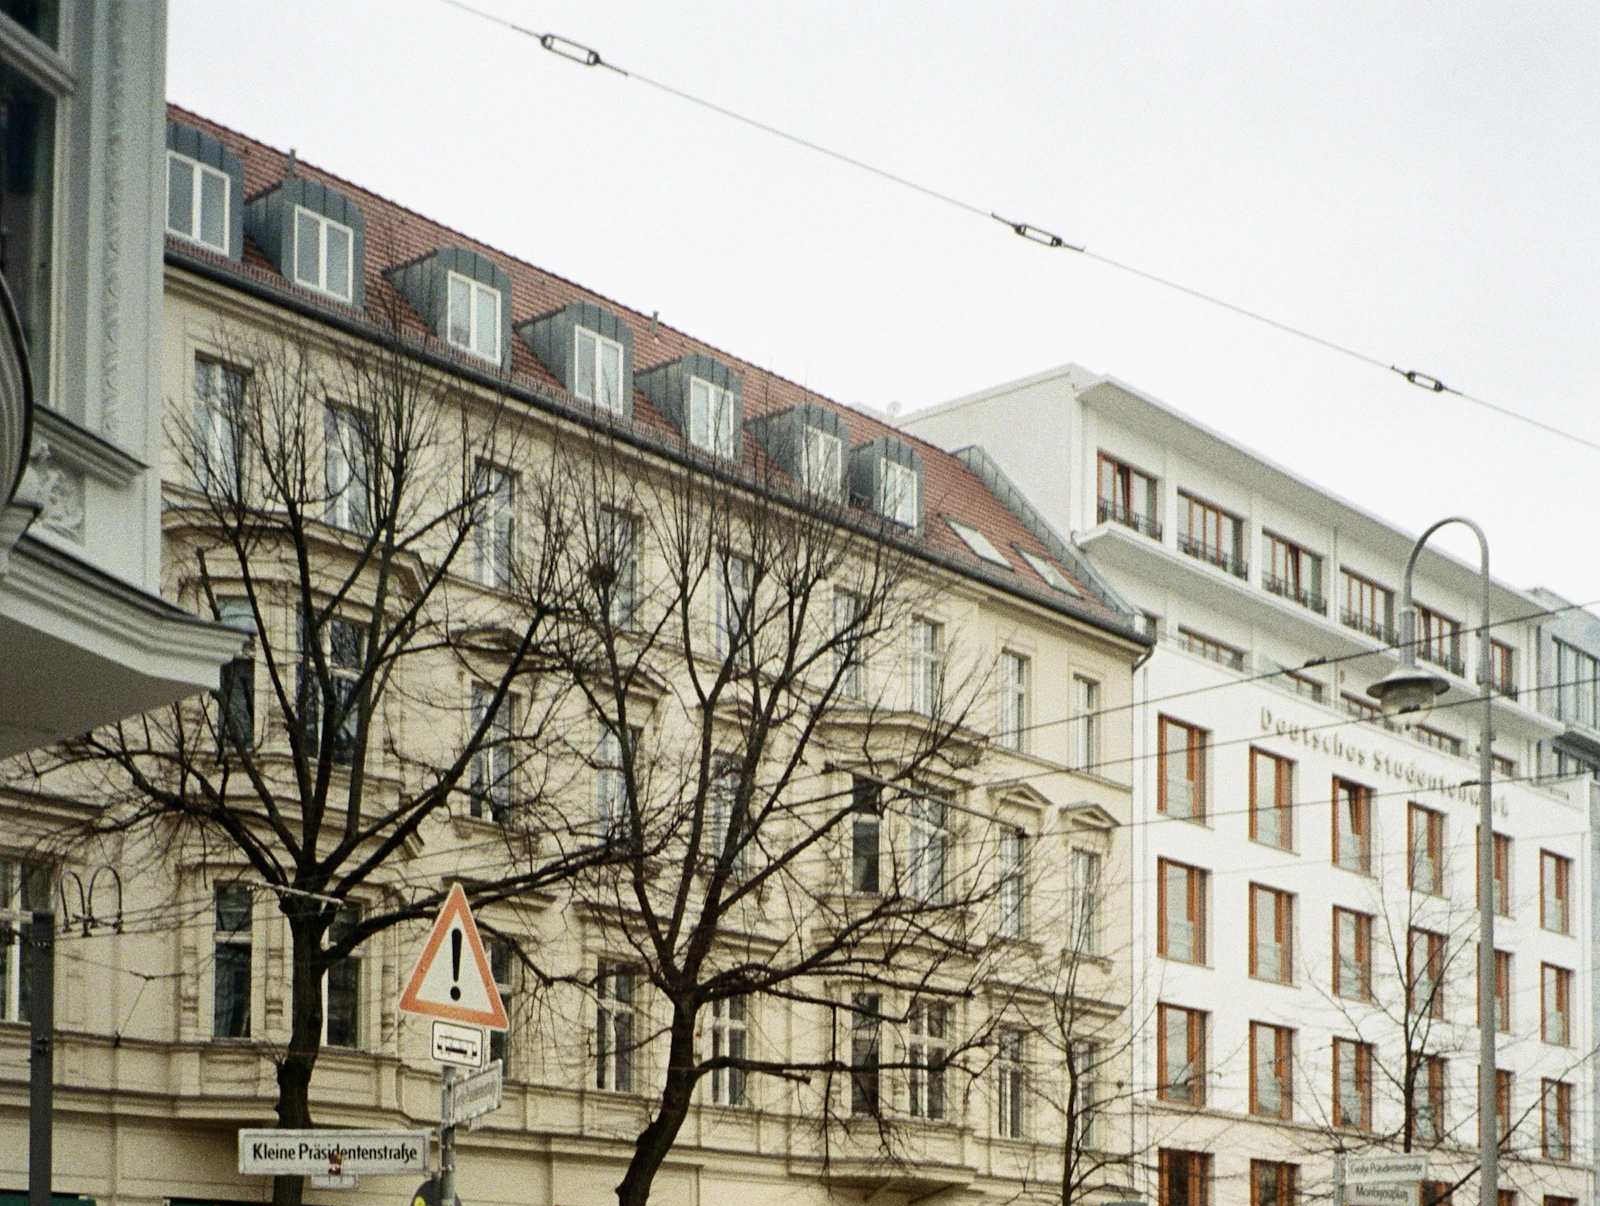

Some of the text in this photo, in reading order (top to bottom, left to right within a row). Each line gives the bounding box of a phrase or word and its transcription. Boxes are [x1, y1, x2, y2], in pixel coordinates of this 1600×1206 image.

[1260, 706, 1509, 818] Deutsches Studentenwrk
[252, 1142, 418, 1163] Kleine Präsidentenstraße
